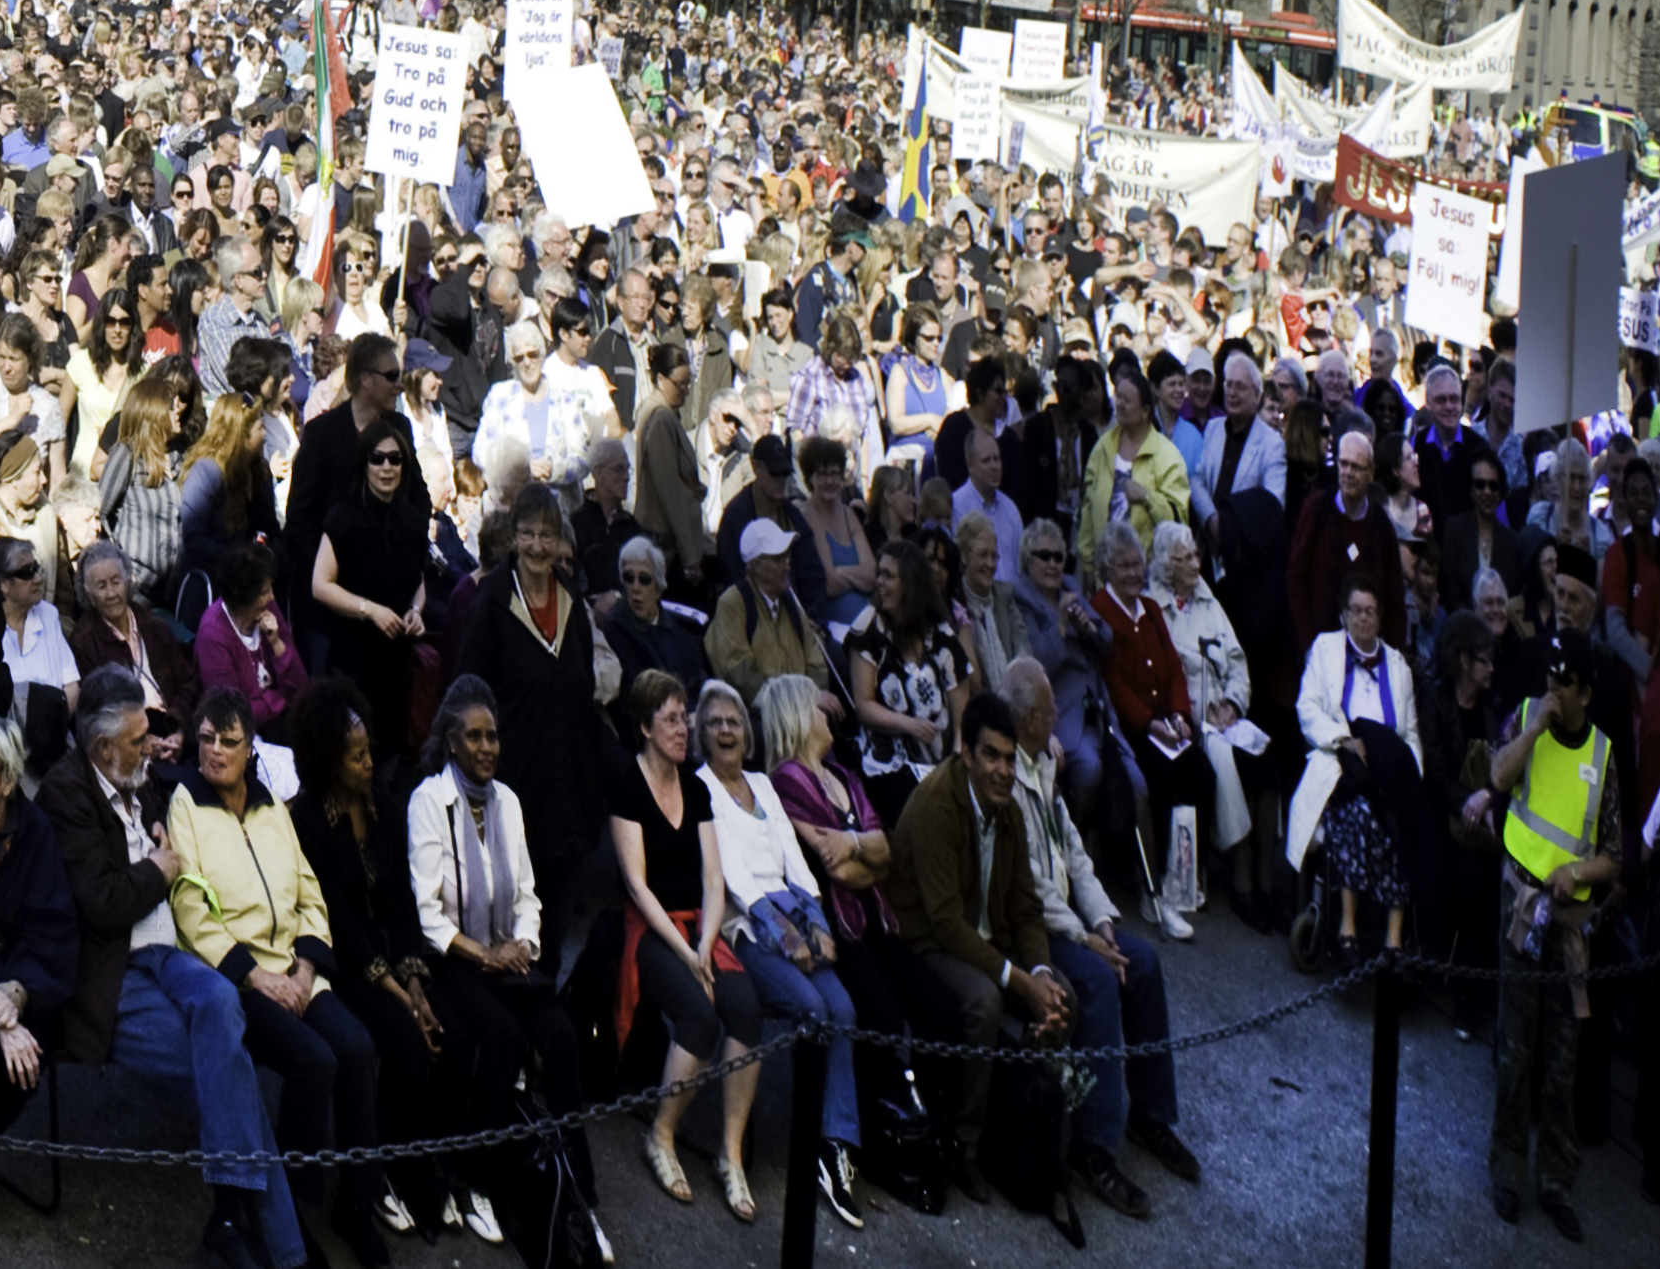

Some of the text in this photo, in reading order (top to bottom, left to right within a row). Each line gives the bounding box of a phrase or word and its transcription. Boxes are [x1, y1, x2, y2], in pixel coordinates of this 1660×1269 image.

[385, 36, 458, 60] Jesus sa:
[518, 30, 563, 43] världens
[394, 63, 445, 88] Tro på
[384, 89, 447, 113] Gud och
[389, 118, 437, 141] tro på
[393, 147, 424, 167] mig.
[1430, 197, 1475, 227] Jesus
[1438, 237, 1460, 254] sa:
[1417, 257, 1481, 296] Följ mig!
[1622, 316, 1650, 343] SUS
